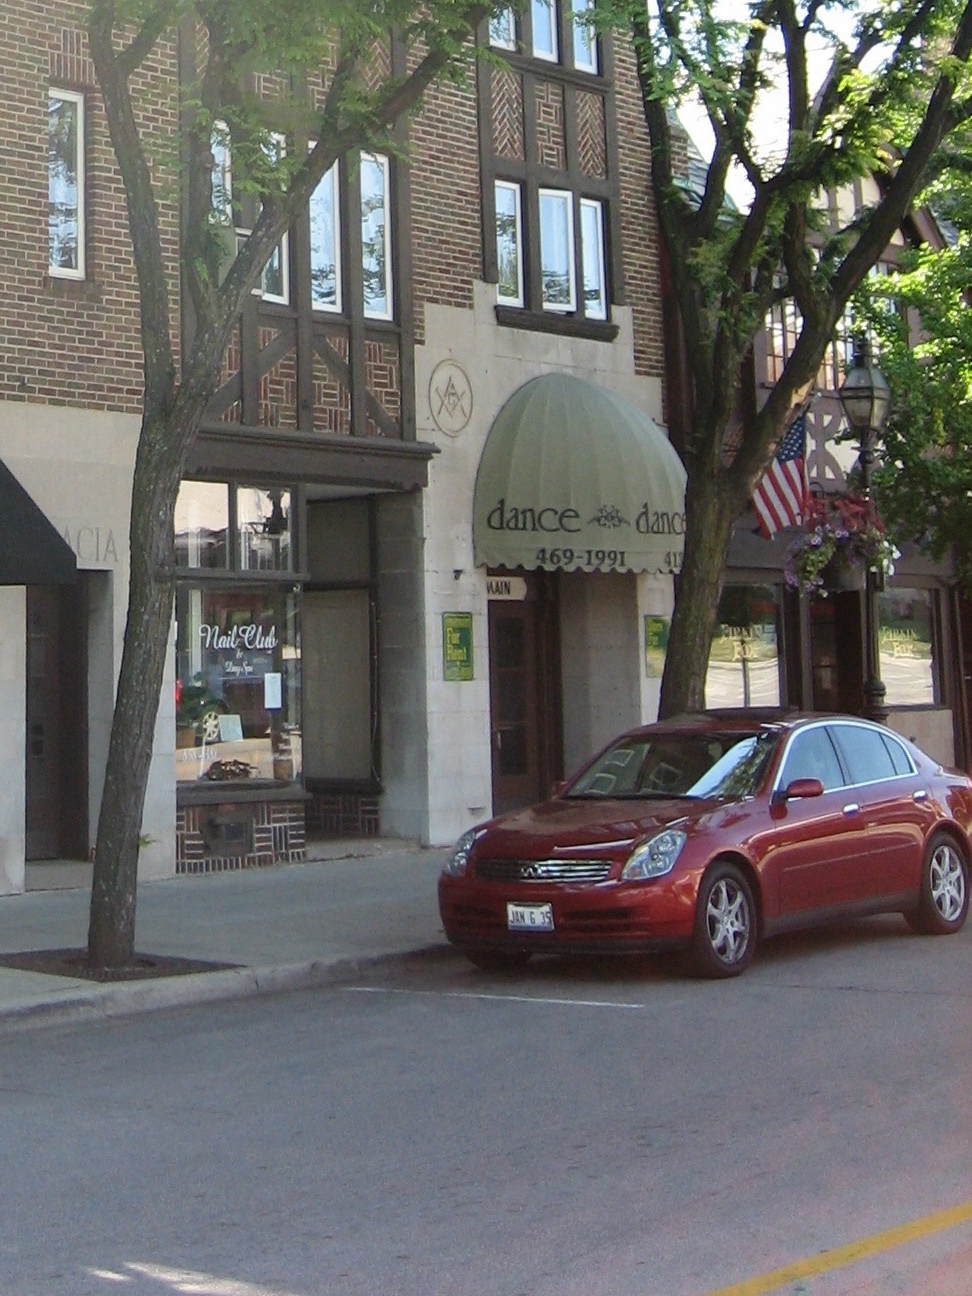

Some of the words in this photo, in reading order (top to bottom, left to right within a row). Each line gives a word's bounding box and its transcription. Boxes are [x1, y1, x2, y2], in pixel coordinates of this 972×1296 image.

[487, 498, 581, 532] dance
[536, 548, 626, 566] 469-1991
[199, 624, 239, 649] Nail
[239, 624, 278, 649] Club
